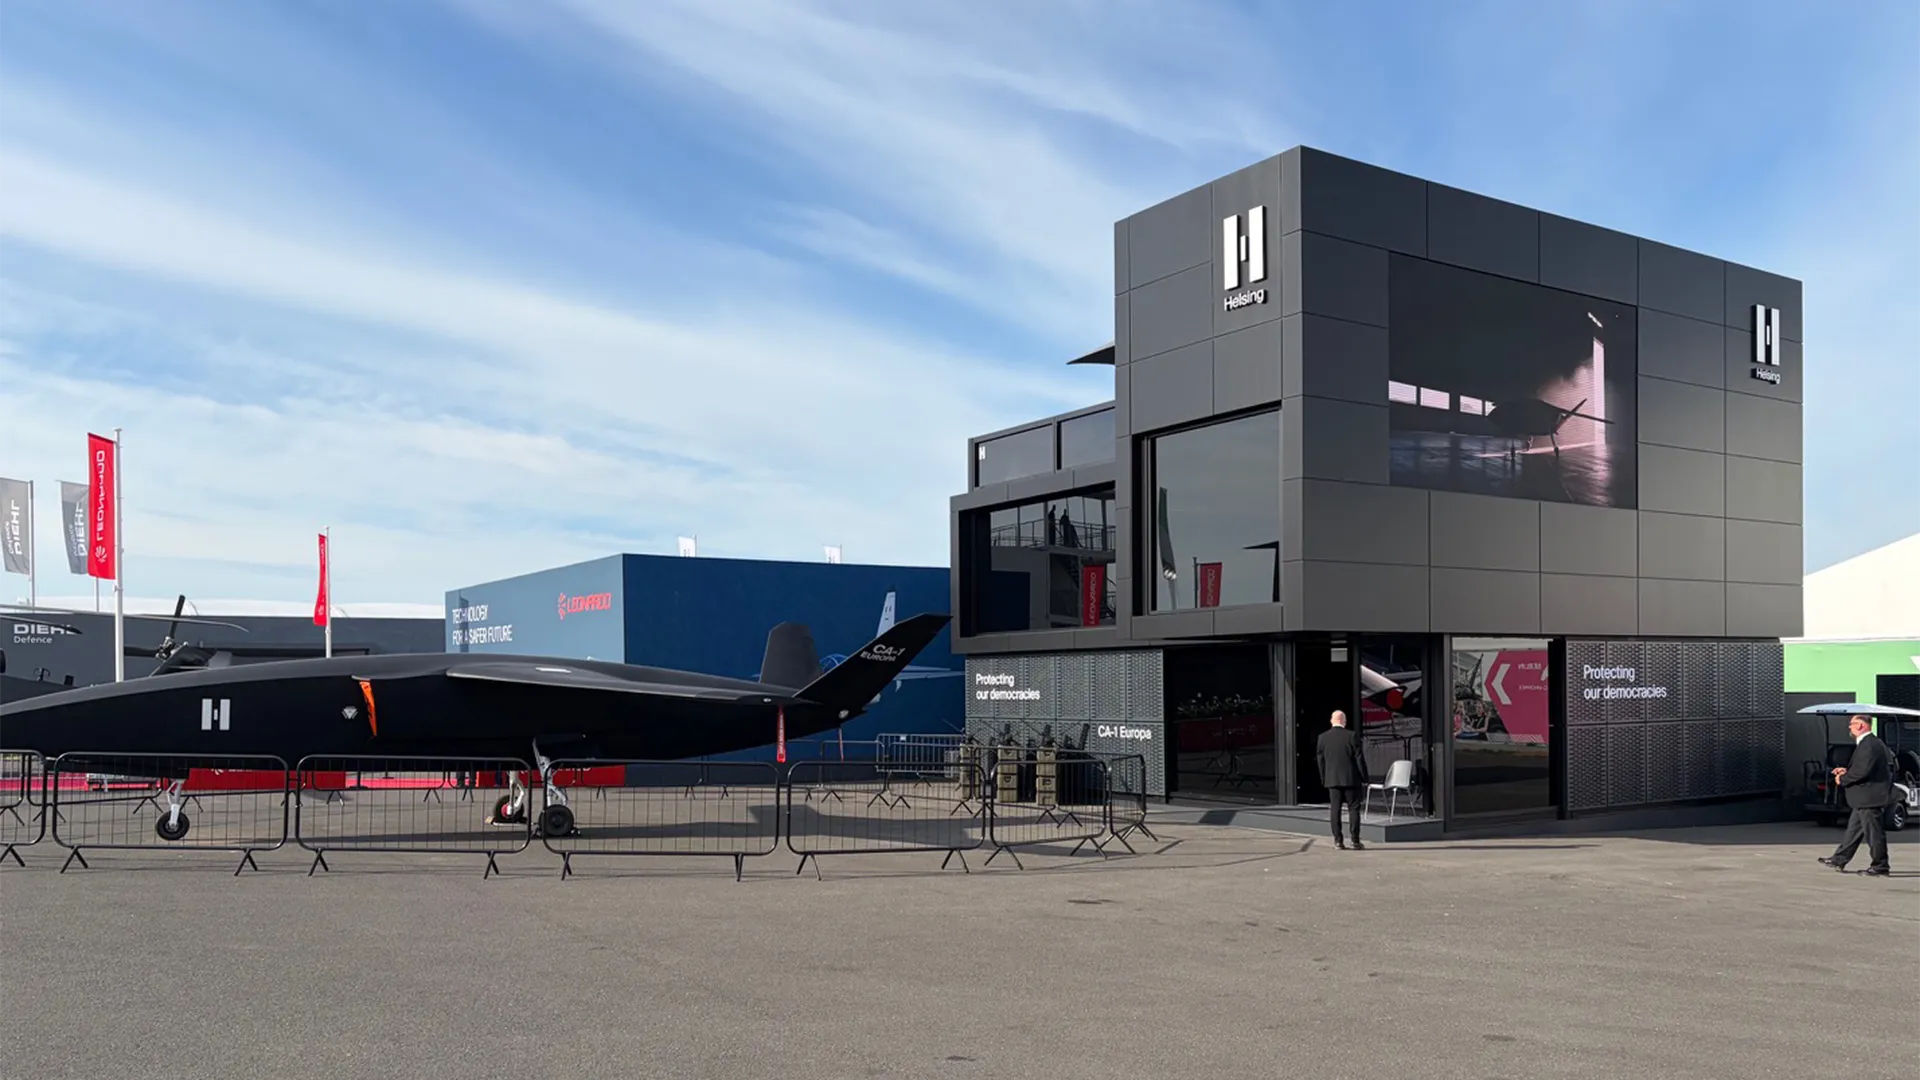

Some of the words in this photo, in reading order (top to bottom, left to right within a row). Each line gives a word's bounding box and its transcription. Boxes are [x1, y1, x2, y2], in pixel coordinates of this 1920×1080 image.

[1224, 289, 1265, 311] Helsing
[1756, 367, 1781, 385] Helsing
[452, 604, 488, 624] TECHNOLOGY
[14, 636, 53, 644] Defence
[452, 629, 464, 645] FOR
[469, 627, 488, 645] SAFER
[488, 625, 513, 643] FUTURE
[860, 650, 897, 662] EUROPA
[873, 643, 906, 656] CA-1
[975, 673, 1015, 687] Protecting
[1583, 664, 1636, 682] Protecting
[975, 690, 989, 700] our
[989, 688, 1040, 700] democracies
[1583, 687, 1602, 700] our
[1603, 684, 1667, 699] democracies
[1098, 724, 1119, 738] CA-1
[1119, 725, 1152, 741] Europa
